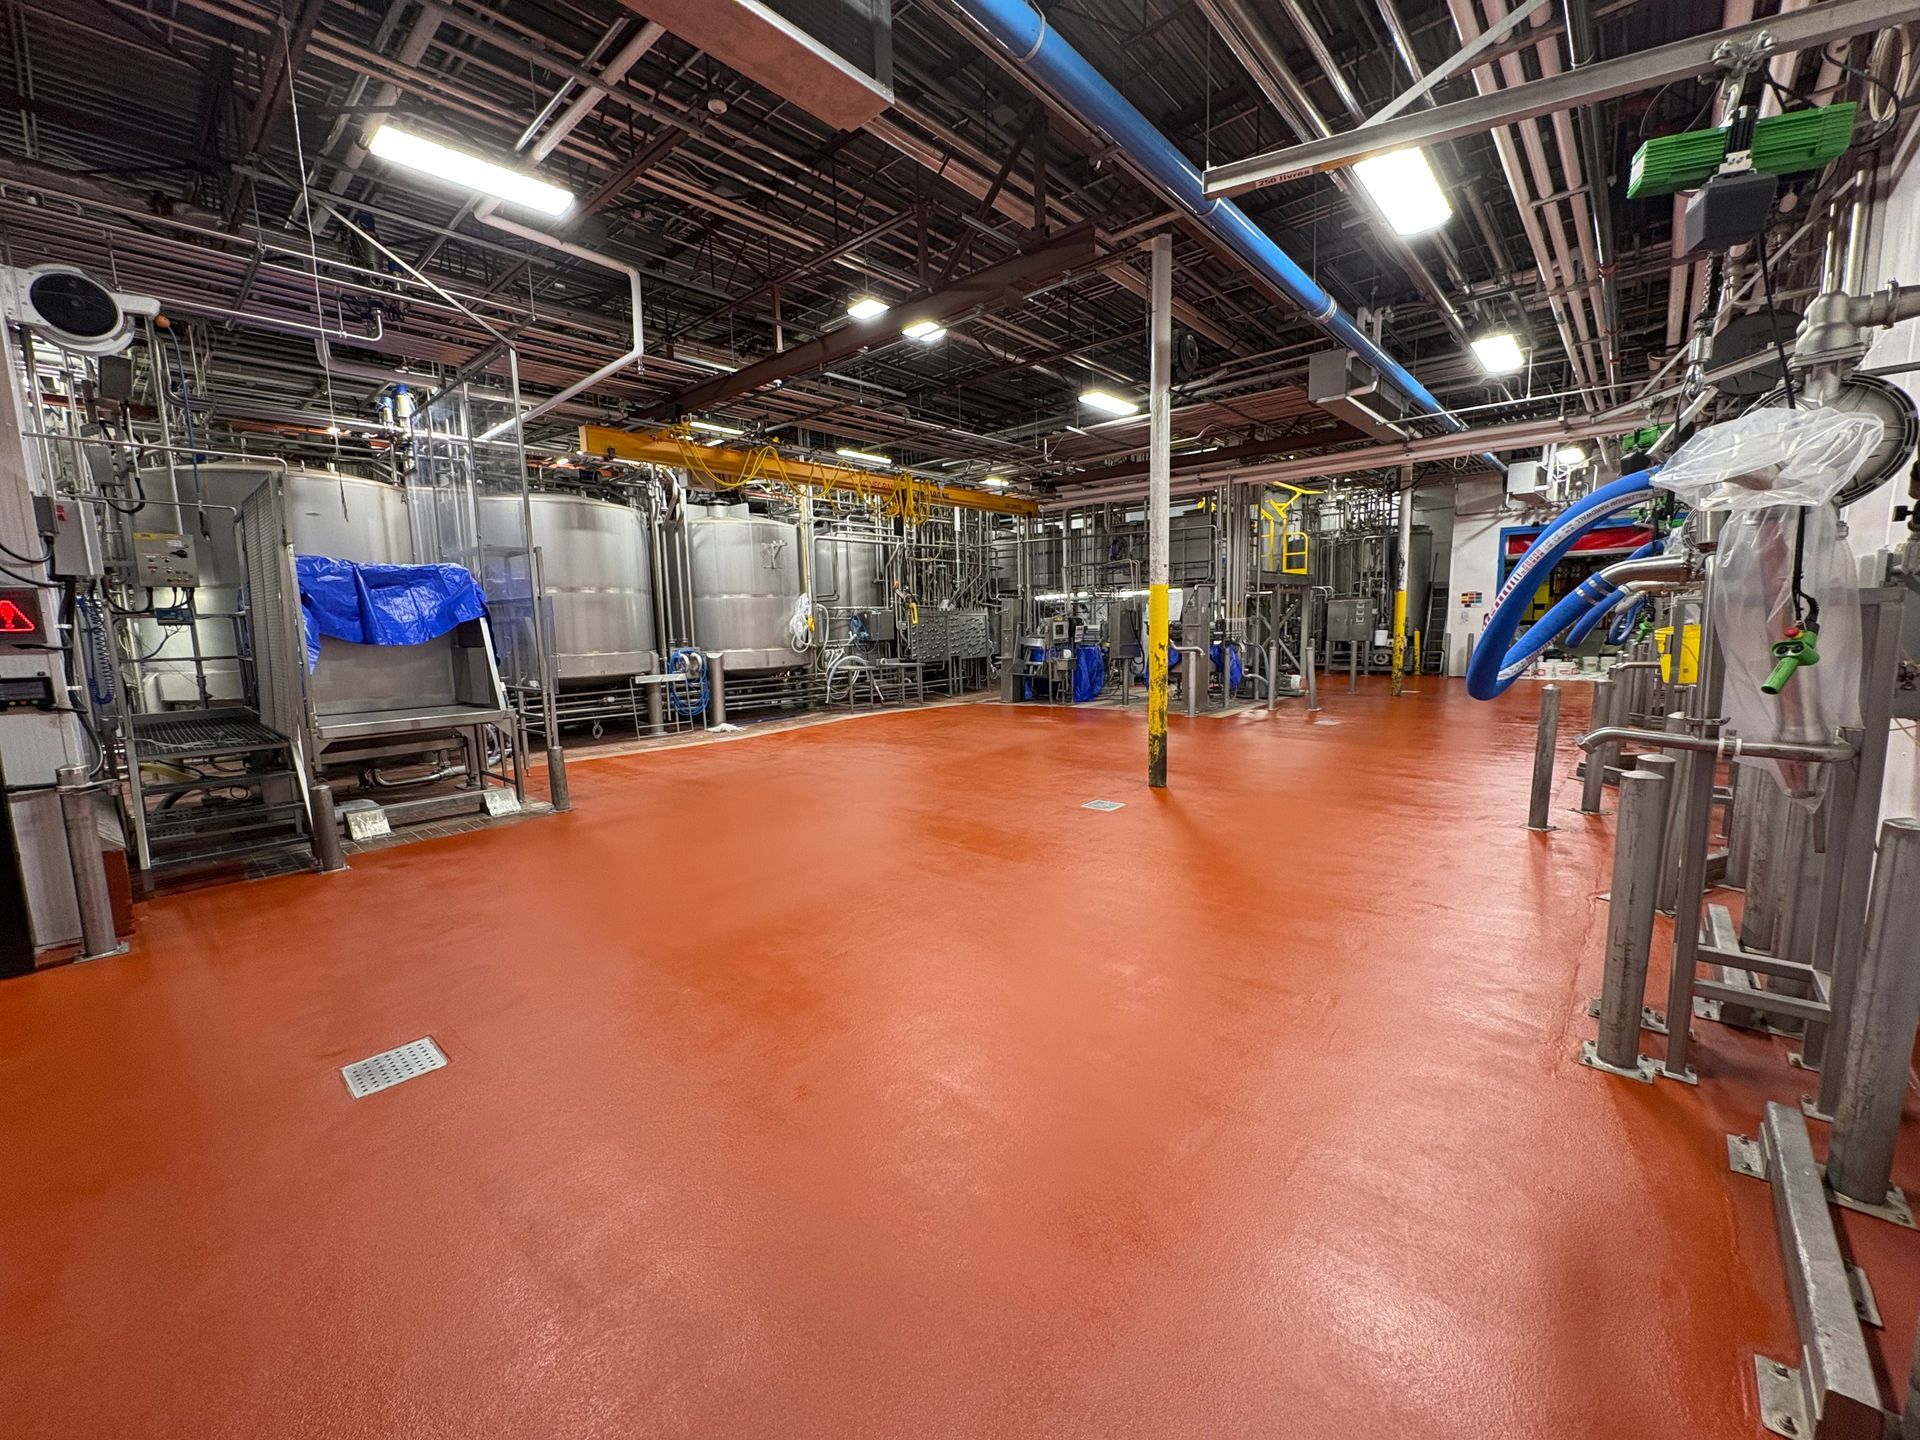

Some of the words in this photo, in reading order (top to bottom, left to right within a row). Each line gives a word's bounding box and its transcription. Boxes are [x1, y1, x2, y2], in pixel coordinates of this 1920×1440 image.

[1258, 178, 1277, 187] 250
[1279, 170, 1310, 181] livres
[1575, 503, 1610, 524] HARDWALL
